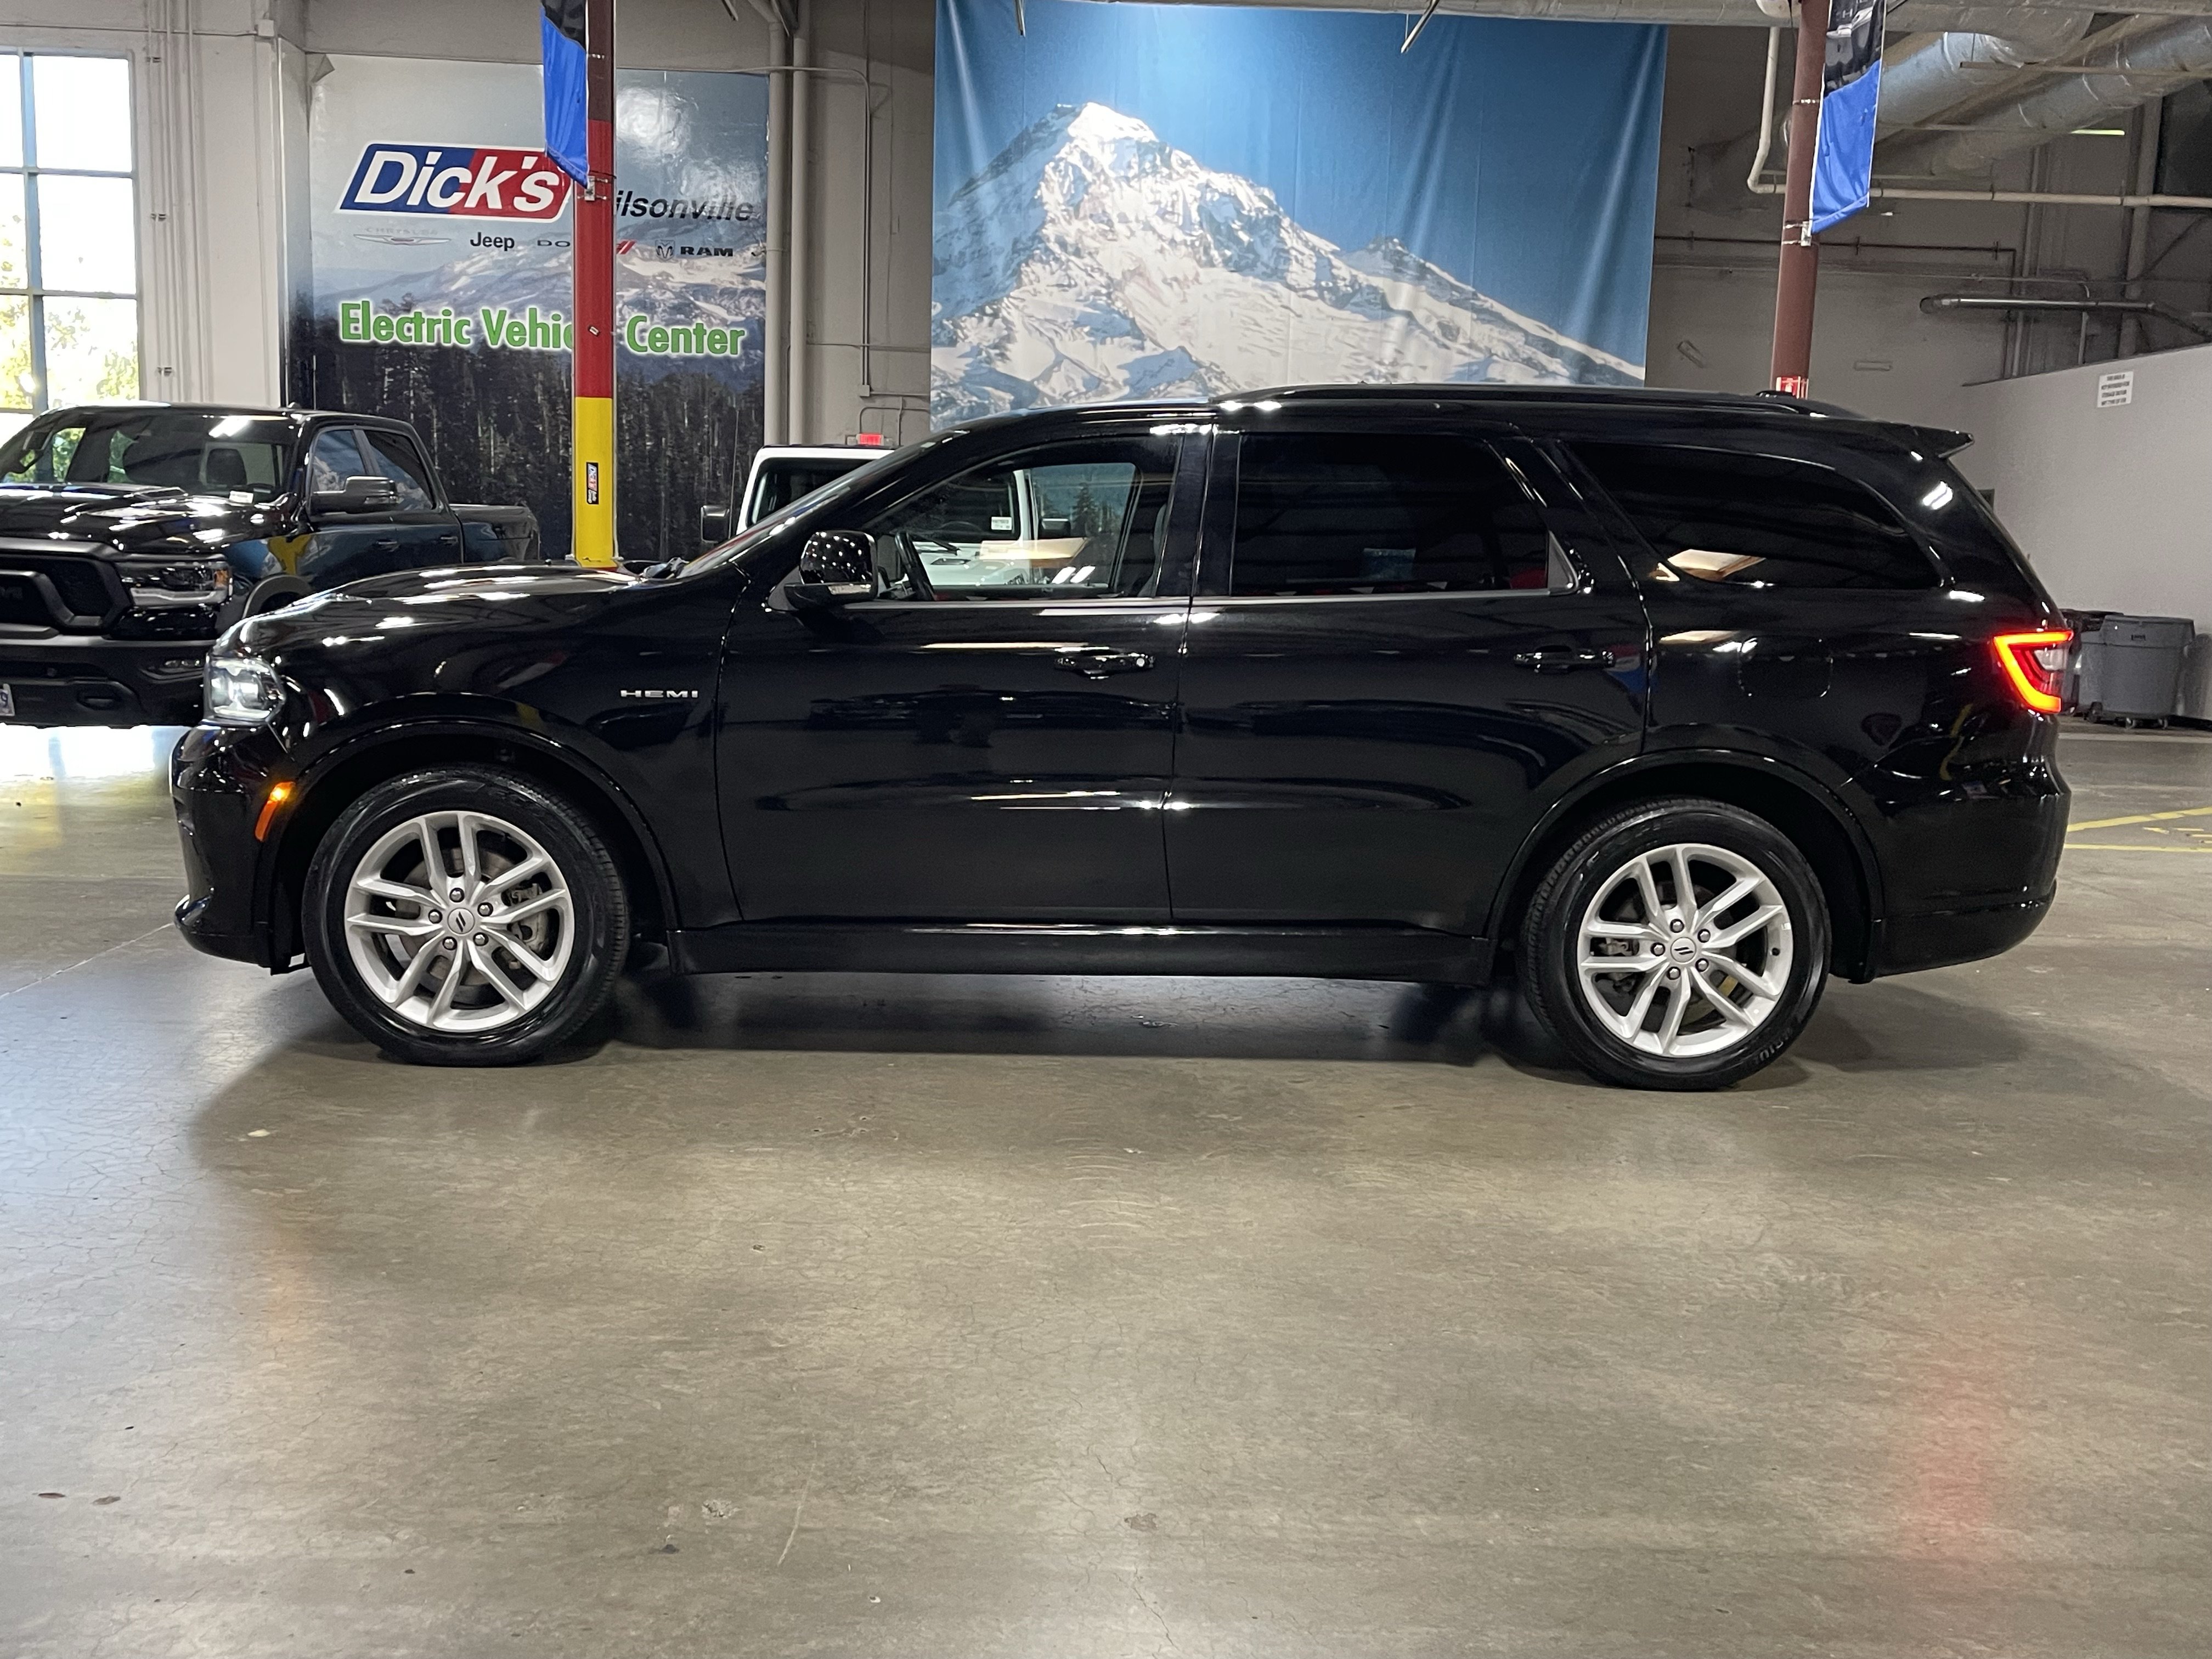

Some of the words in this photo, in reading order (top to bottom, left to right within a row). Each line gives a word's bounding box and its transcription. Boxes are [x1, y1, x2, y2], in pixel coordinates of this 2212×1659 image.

[354, 150, 558, 212] Dick's
[616, 190, 754, 221] ilsonville
[470, 232, 515, 251] Jeep
[680, 246, 733, 257] RAM
[342, 301, 470, 345] Electric
[482, 308, 573, 349] Vehic
[627, 315, 745, 355] Center
[620, 690, 698, 698] HEMI
